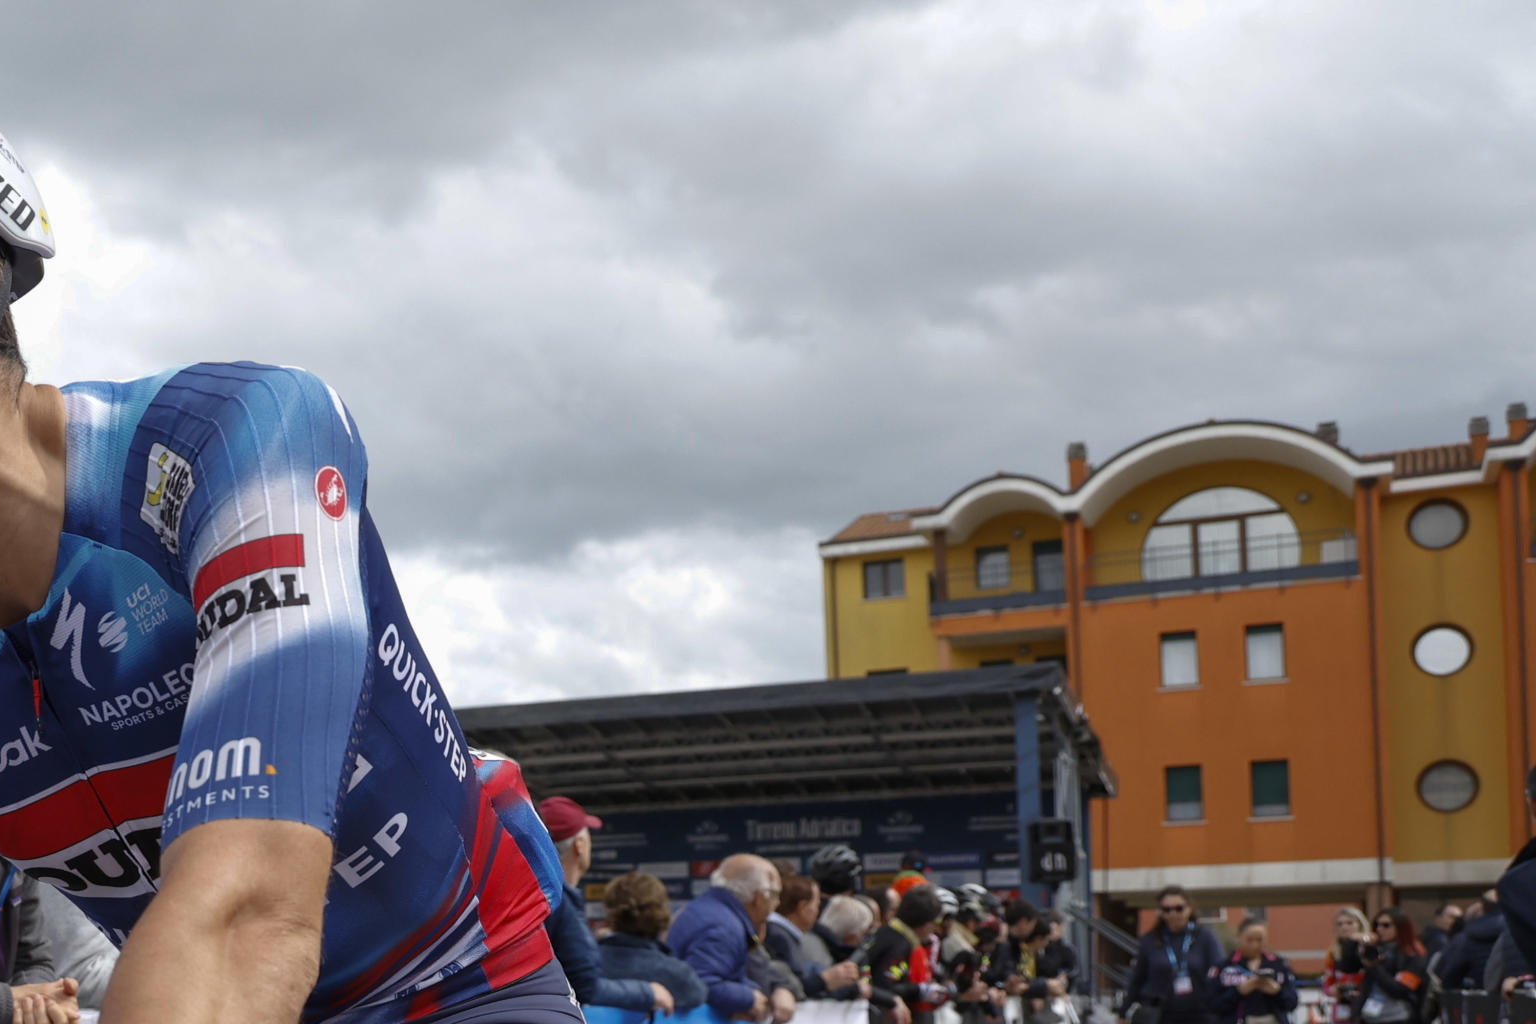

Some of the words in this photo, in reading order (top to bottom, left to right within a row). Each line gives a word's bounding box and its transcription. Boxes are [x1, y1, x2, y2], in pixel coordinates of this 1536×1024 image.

[127, 583, 151, 608] UCI
[131, 588, 169, 622] WORLD
[196, 573, 311, 644] UDAL
[136, 607, 169, 636] TEAM
[111, 706, 155, 731] SPORTS
[156, 702, 166, 717] &
